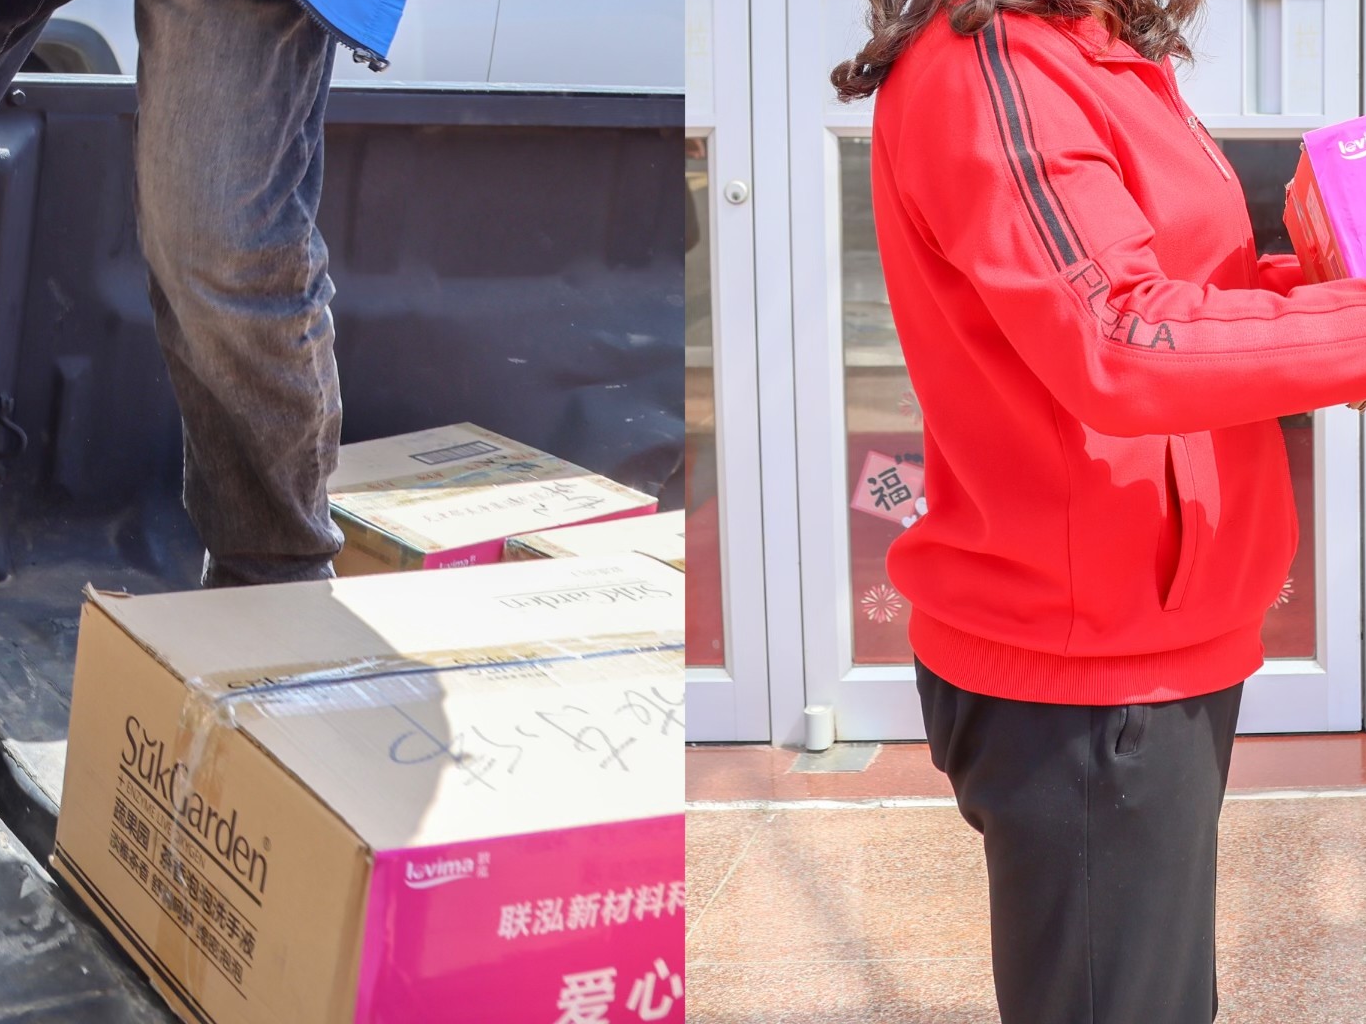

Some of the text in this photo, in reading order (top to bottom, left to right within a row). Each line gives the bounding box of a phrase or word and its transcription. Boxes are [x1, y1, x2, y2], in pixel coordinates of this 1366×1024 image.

[867, 466, 912, 512] 福
[126, 780, 156, 819] ENZYME
[113, 796, 150, 852] 蔬果园
